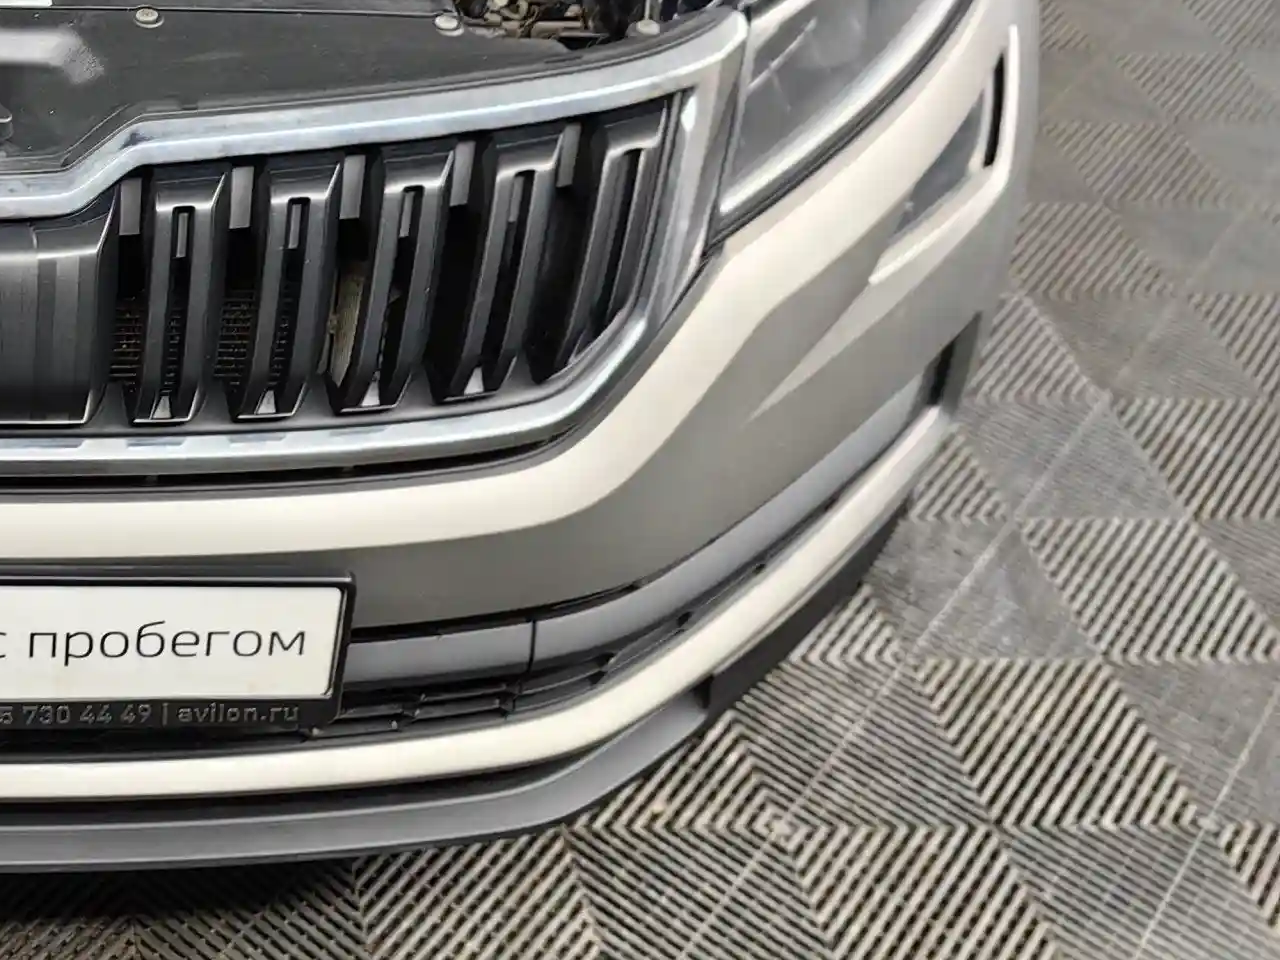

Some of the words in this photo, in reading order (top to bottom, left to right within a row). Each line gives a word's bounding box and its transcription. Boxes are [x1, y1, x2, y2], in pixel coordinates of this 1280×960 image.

[28, 620, 306, 667] пробегом
[22, 704, 71, 725] 730
[79, 704, 113, 724] 44
[120, 702, 152, 724] 49
[177, 702, 300, 723] avilon.ru
